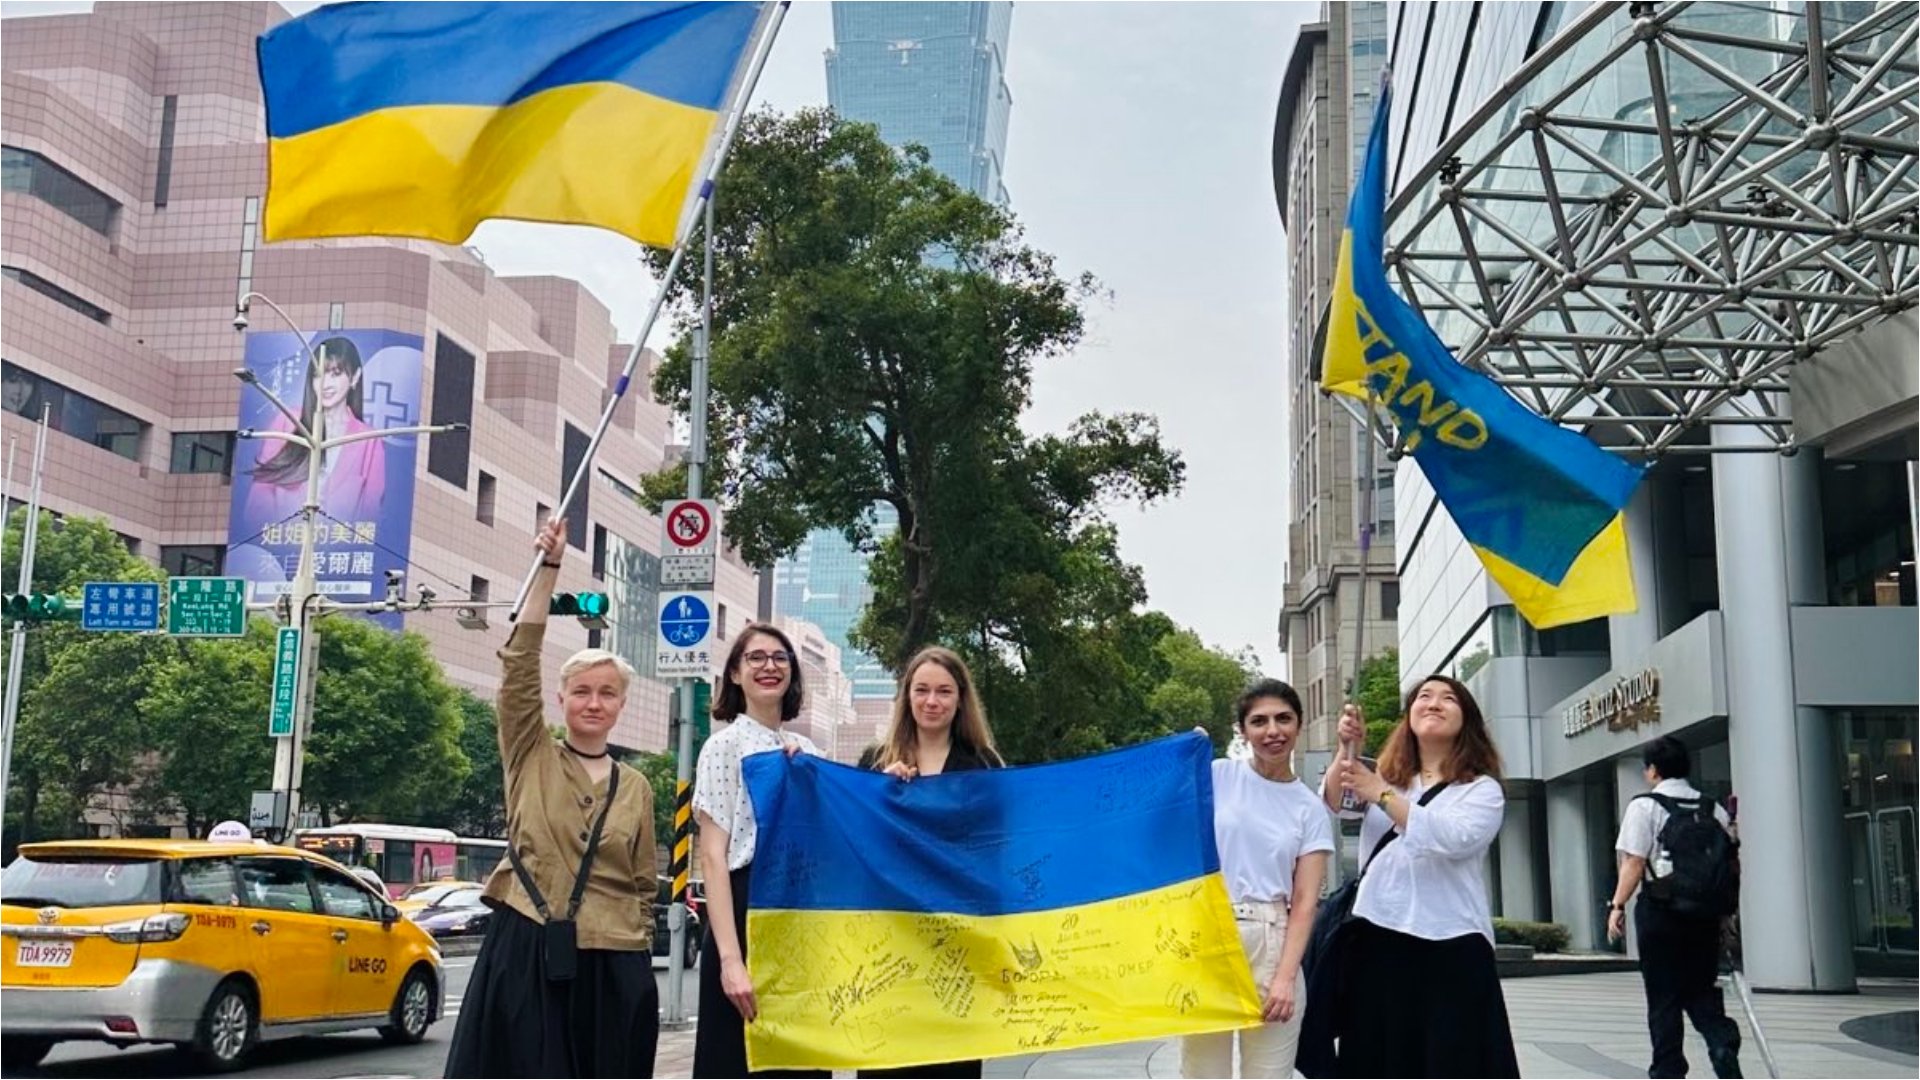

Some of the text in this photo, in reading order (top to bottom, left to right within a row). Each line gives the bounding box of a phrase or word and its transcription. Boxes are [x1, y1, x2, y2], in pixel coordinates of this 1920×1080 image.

[658, 650, 710, 664] 行人優先
[349, 956, 387, 974] LINE GO
